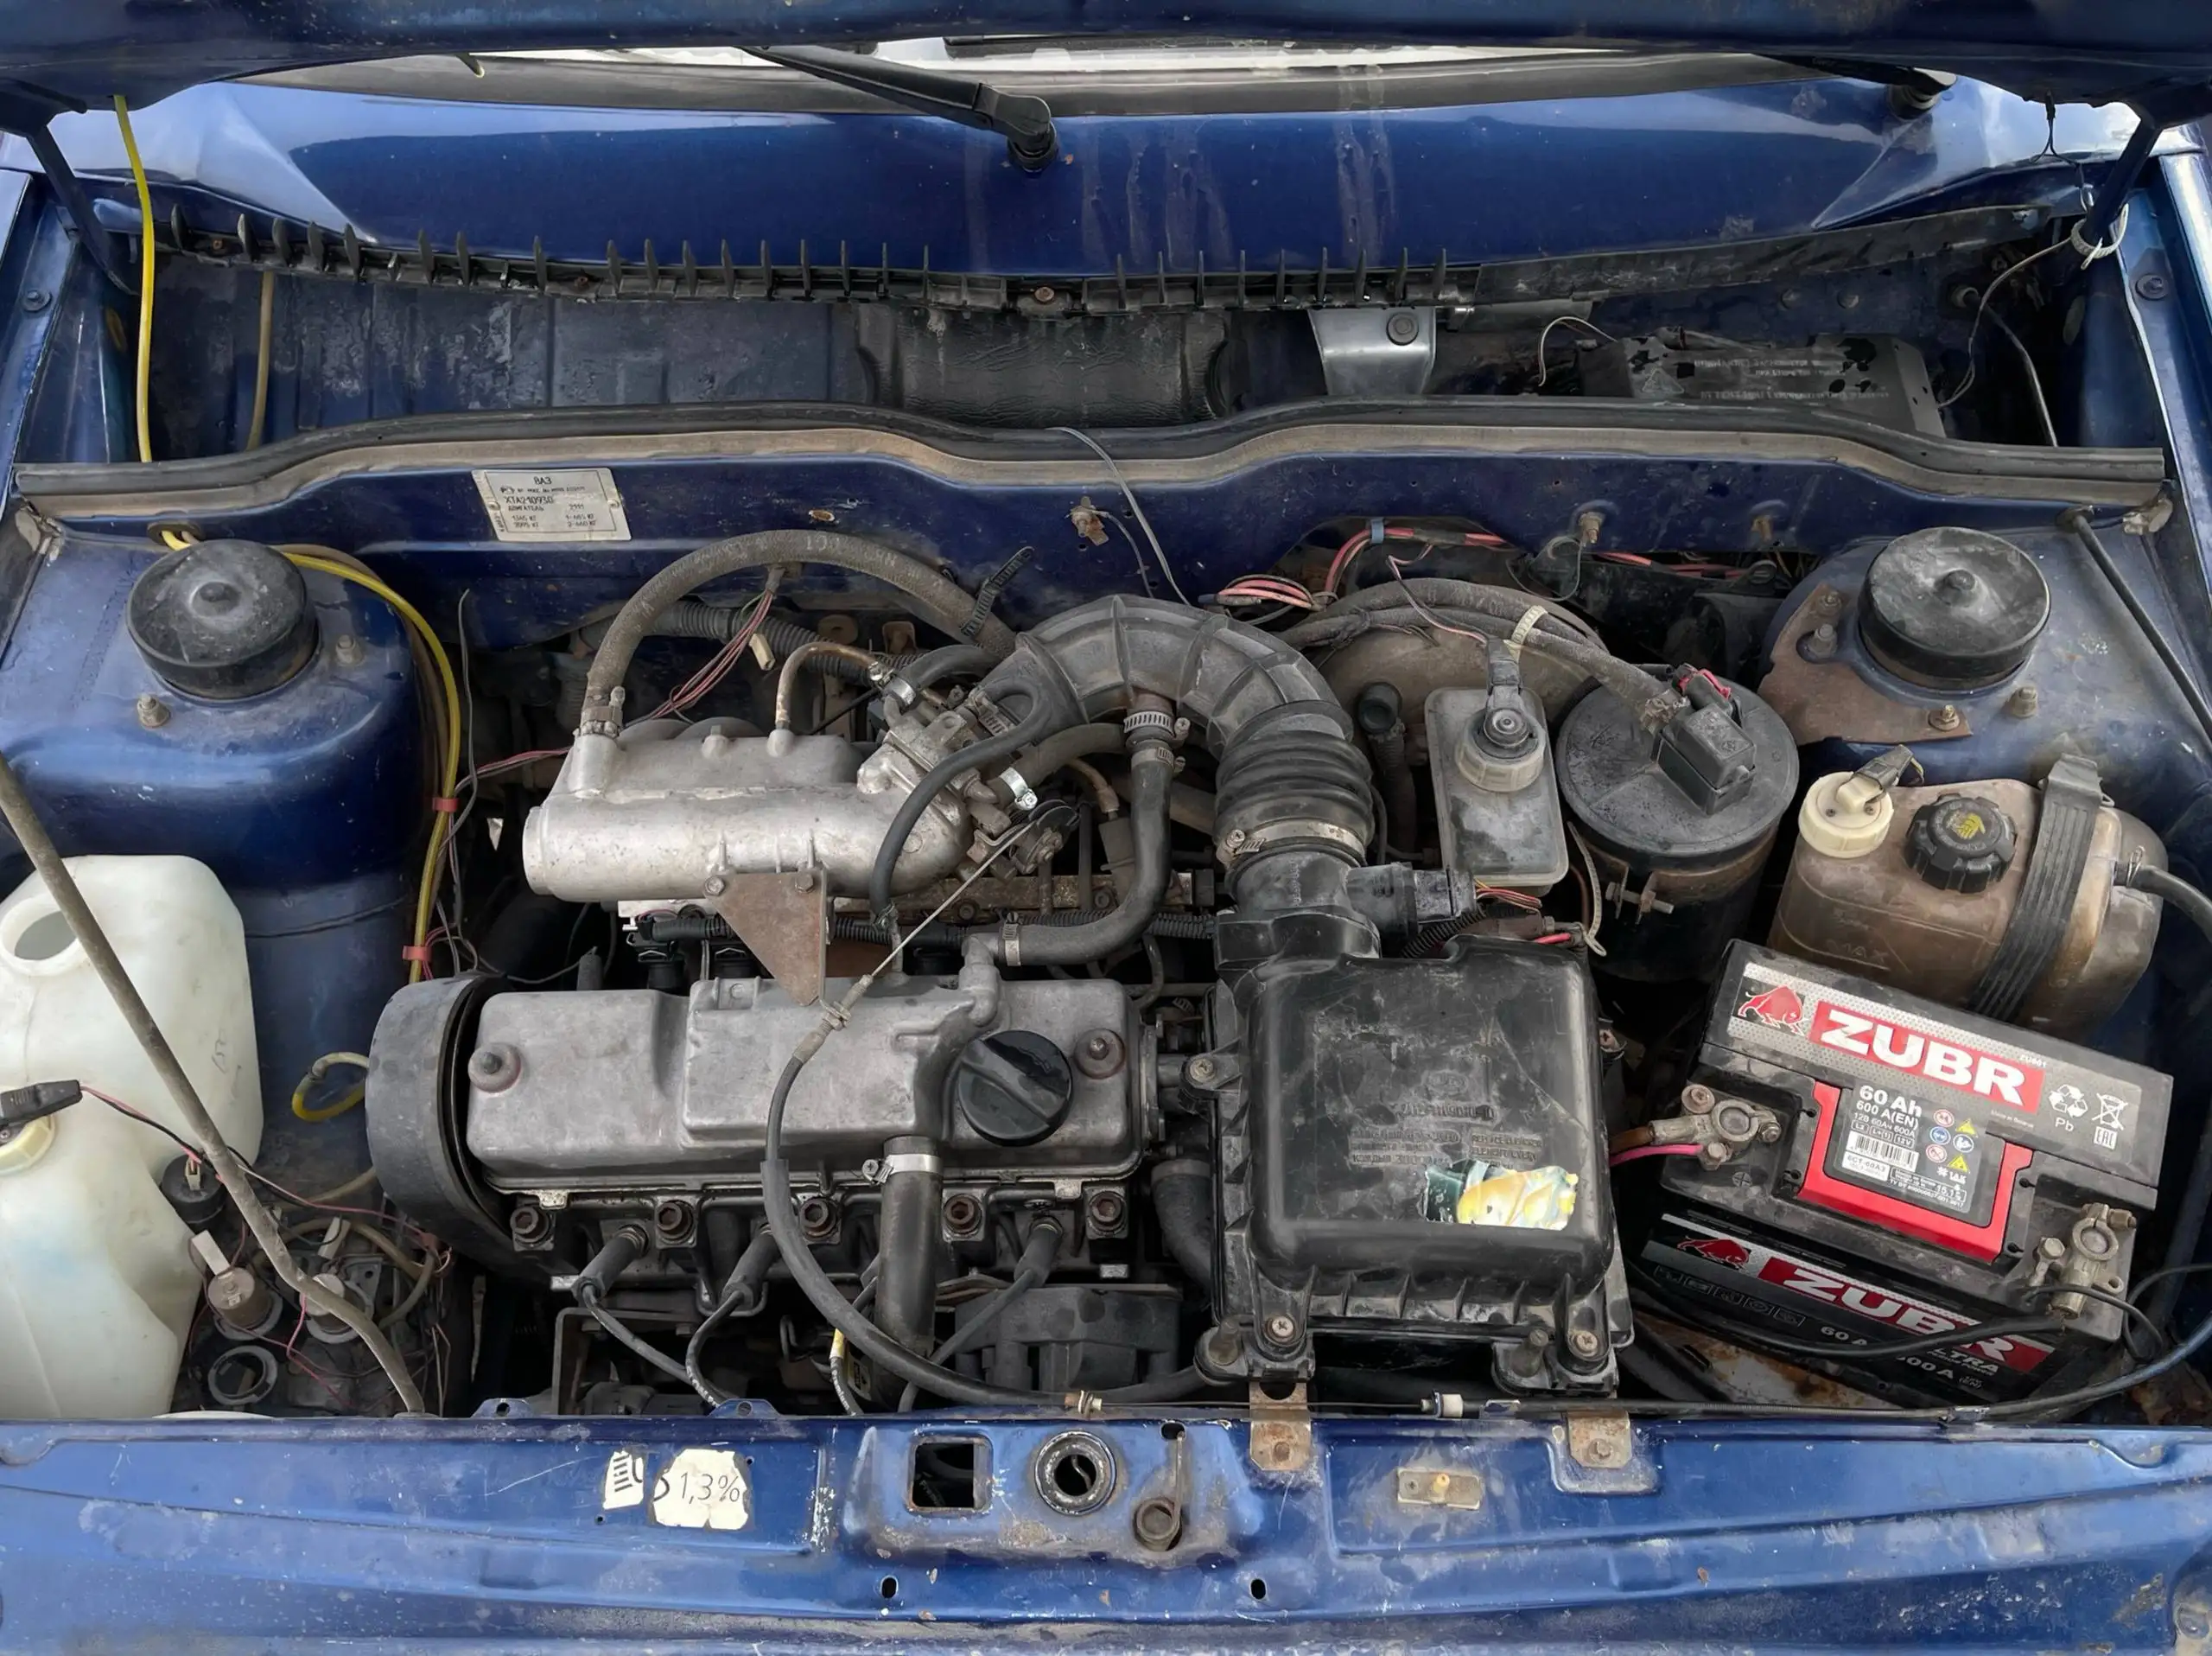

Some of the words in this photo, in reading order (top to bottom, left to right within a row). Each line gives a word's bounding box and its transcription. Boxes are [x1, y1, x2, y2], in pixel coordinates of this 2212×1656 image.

[533, 476, 552, 485] ВАЗ
[1821, 1009, 2025, 1106] ZUBR
[1859, 1085, 1888, 1105] 60
[1891, 1096, 1923, 1118] Ah
[1856, 1100, 1878, 1115] 600
[1881, 1109, 1919, 1131] A(EN)
[2056, 1118, 2074, 1132] Pb
[1821, 1326, 1849, 1341] 60
[1896, 1356, 1936, 1371] 00
[1936, 1369, 1953, 1379] A
[680, 1472, 740, 1504] 1,3%
